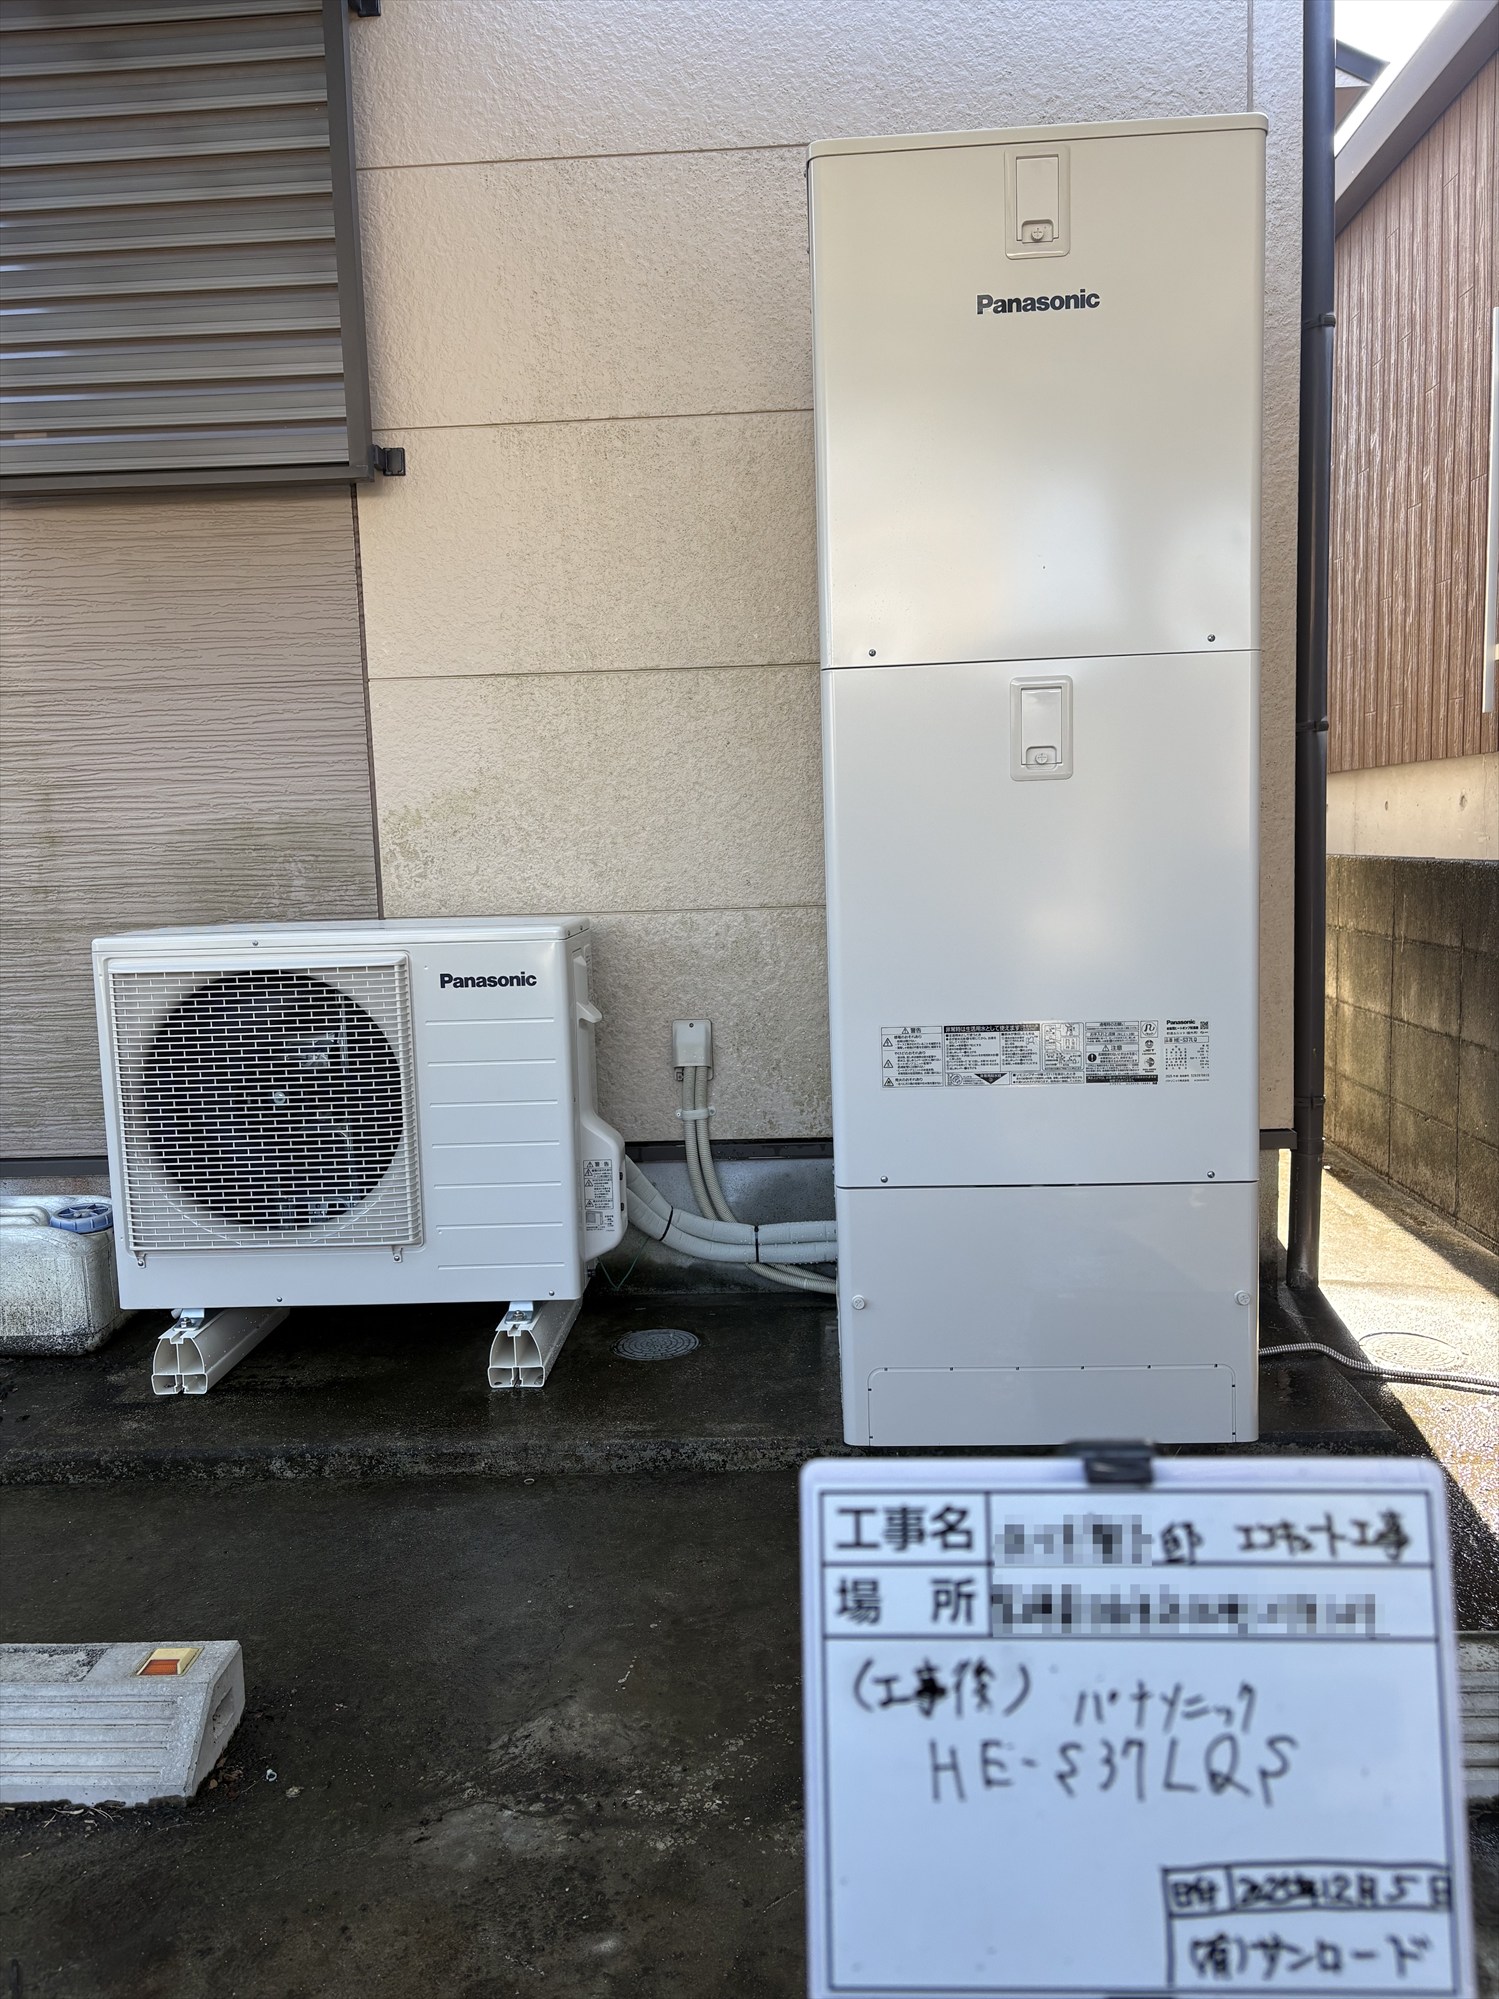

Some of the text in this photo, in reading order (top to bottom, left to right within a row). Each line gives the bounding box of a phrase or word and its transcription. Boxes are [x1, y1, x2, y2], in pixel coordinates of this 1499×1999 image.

[976, 288, 1100, 315] Panasonic
[439, 971, 537, 989] Panasonic
[836, 1504, 974, 1552] 工事名
[929, 1733, 1302, 1808] HE-S37LQS
[1188, 1931, 1434, 1982] (有)サンロード
